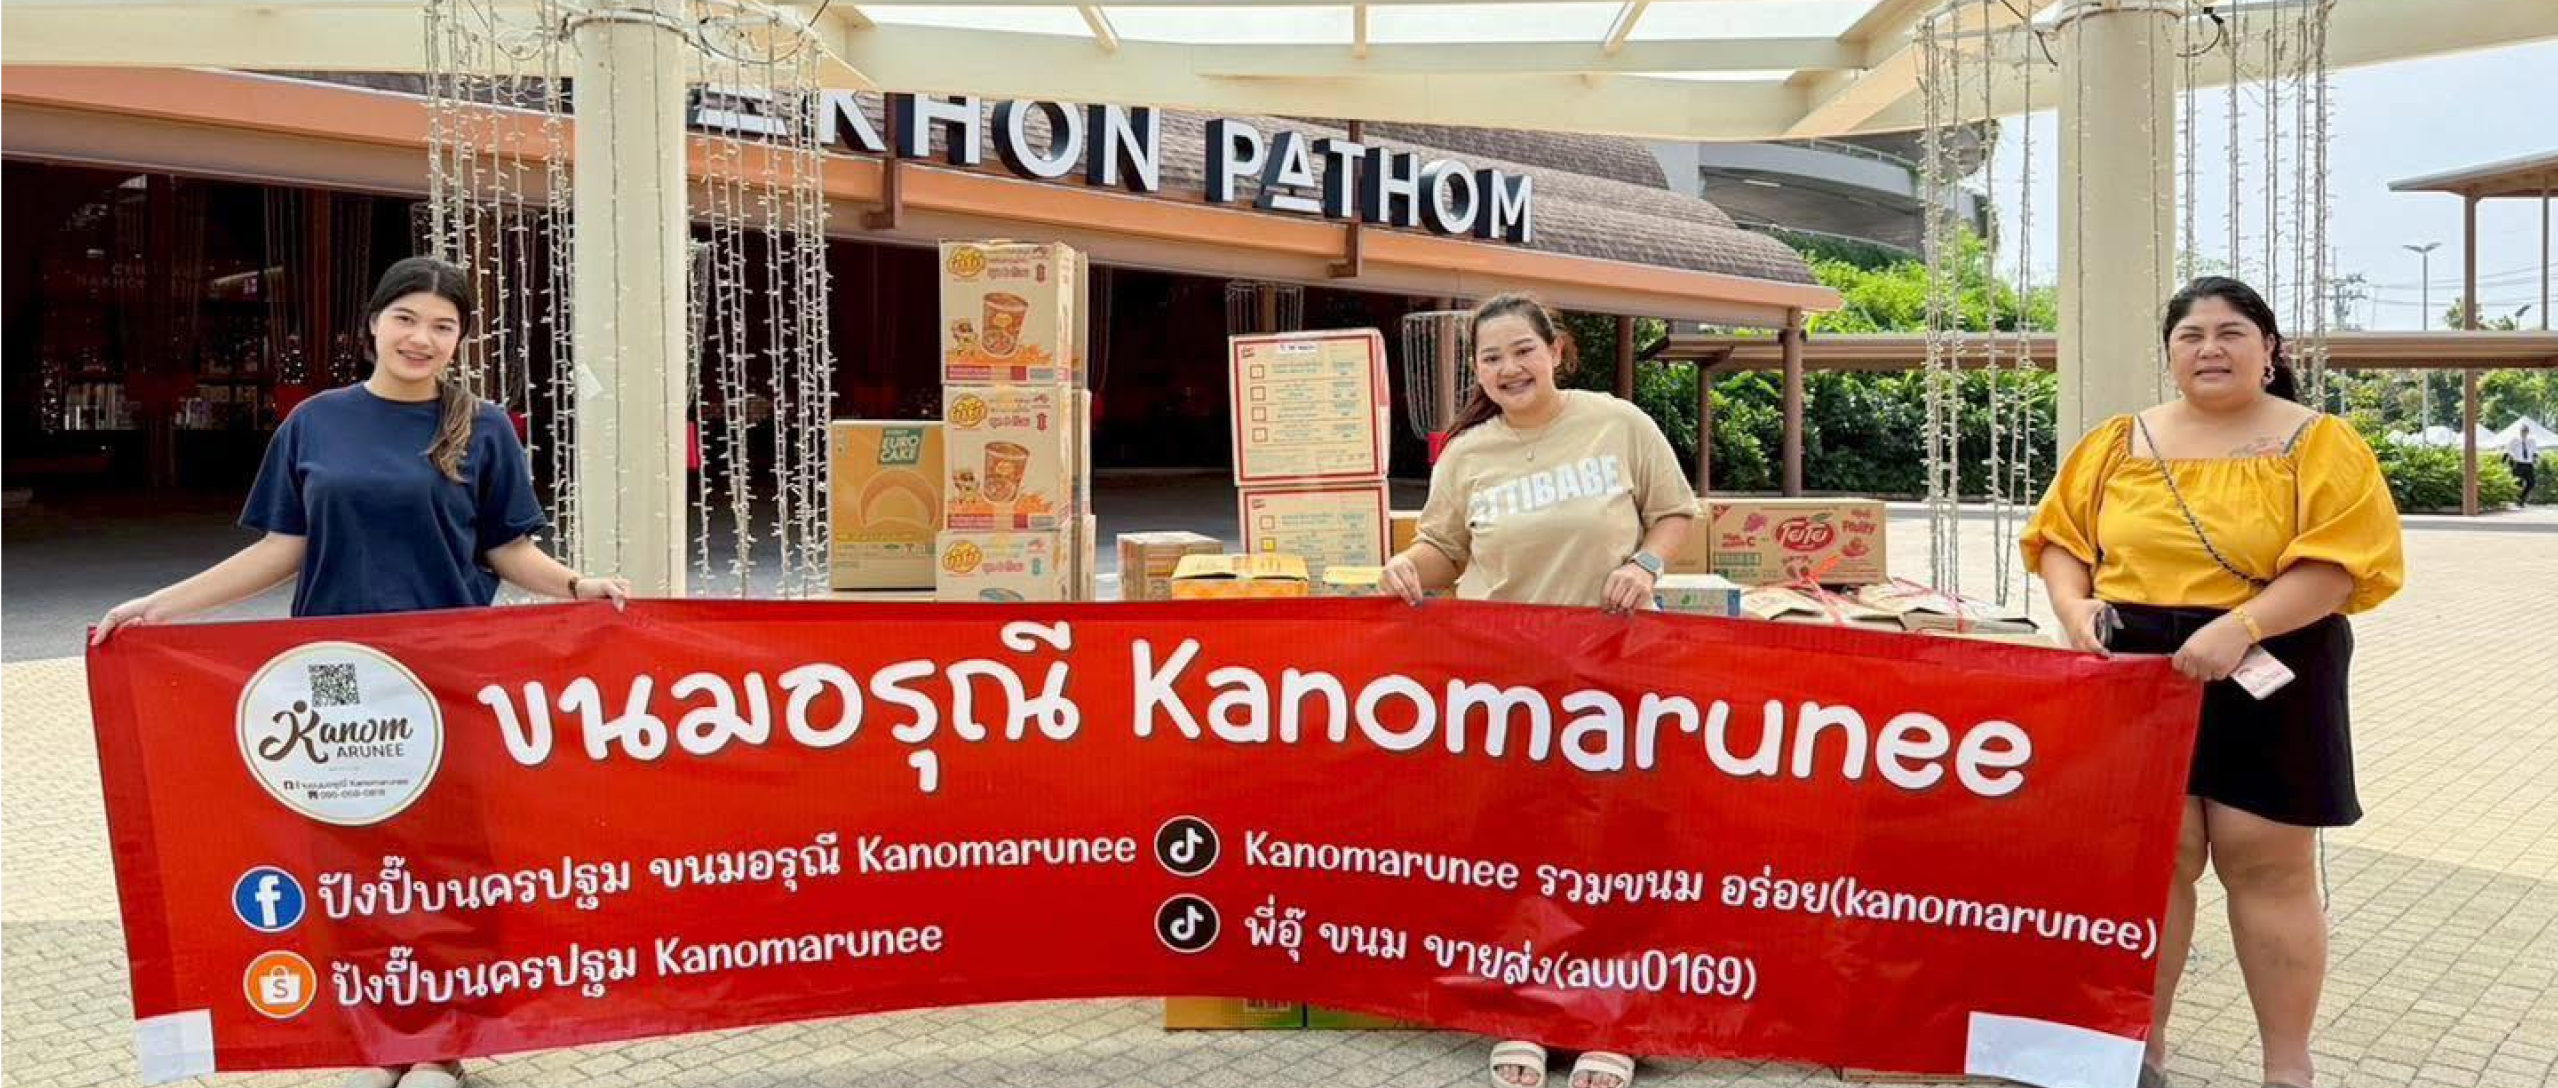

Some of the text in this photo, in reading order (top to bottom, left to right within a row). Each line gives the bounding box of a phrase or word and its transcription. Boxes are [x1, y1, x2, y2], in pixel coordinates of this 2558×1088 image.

[1206, 118, 1533, 243] PATHOM
[258, 700, 413, 764] Kanom
[336, 743, 405, 759] ARUNEE
[477, 621, 2033, 798] ขนมอรุณี Kanomarunee
[648, 832, 841, 892] ขนมอรุณี
[857, 836, 1137, 873] Kanomarunee
[1244, 830, 2158, 959] Kanomarunee รวมขนม อร่อย(kanomarunee)
[654, 925, 943, 976] Kanomarunee
[1244, 894, 1757, 1000] พี่อุ๊ ขนม ขายส่ง(auu0169)
